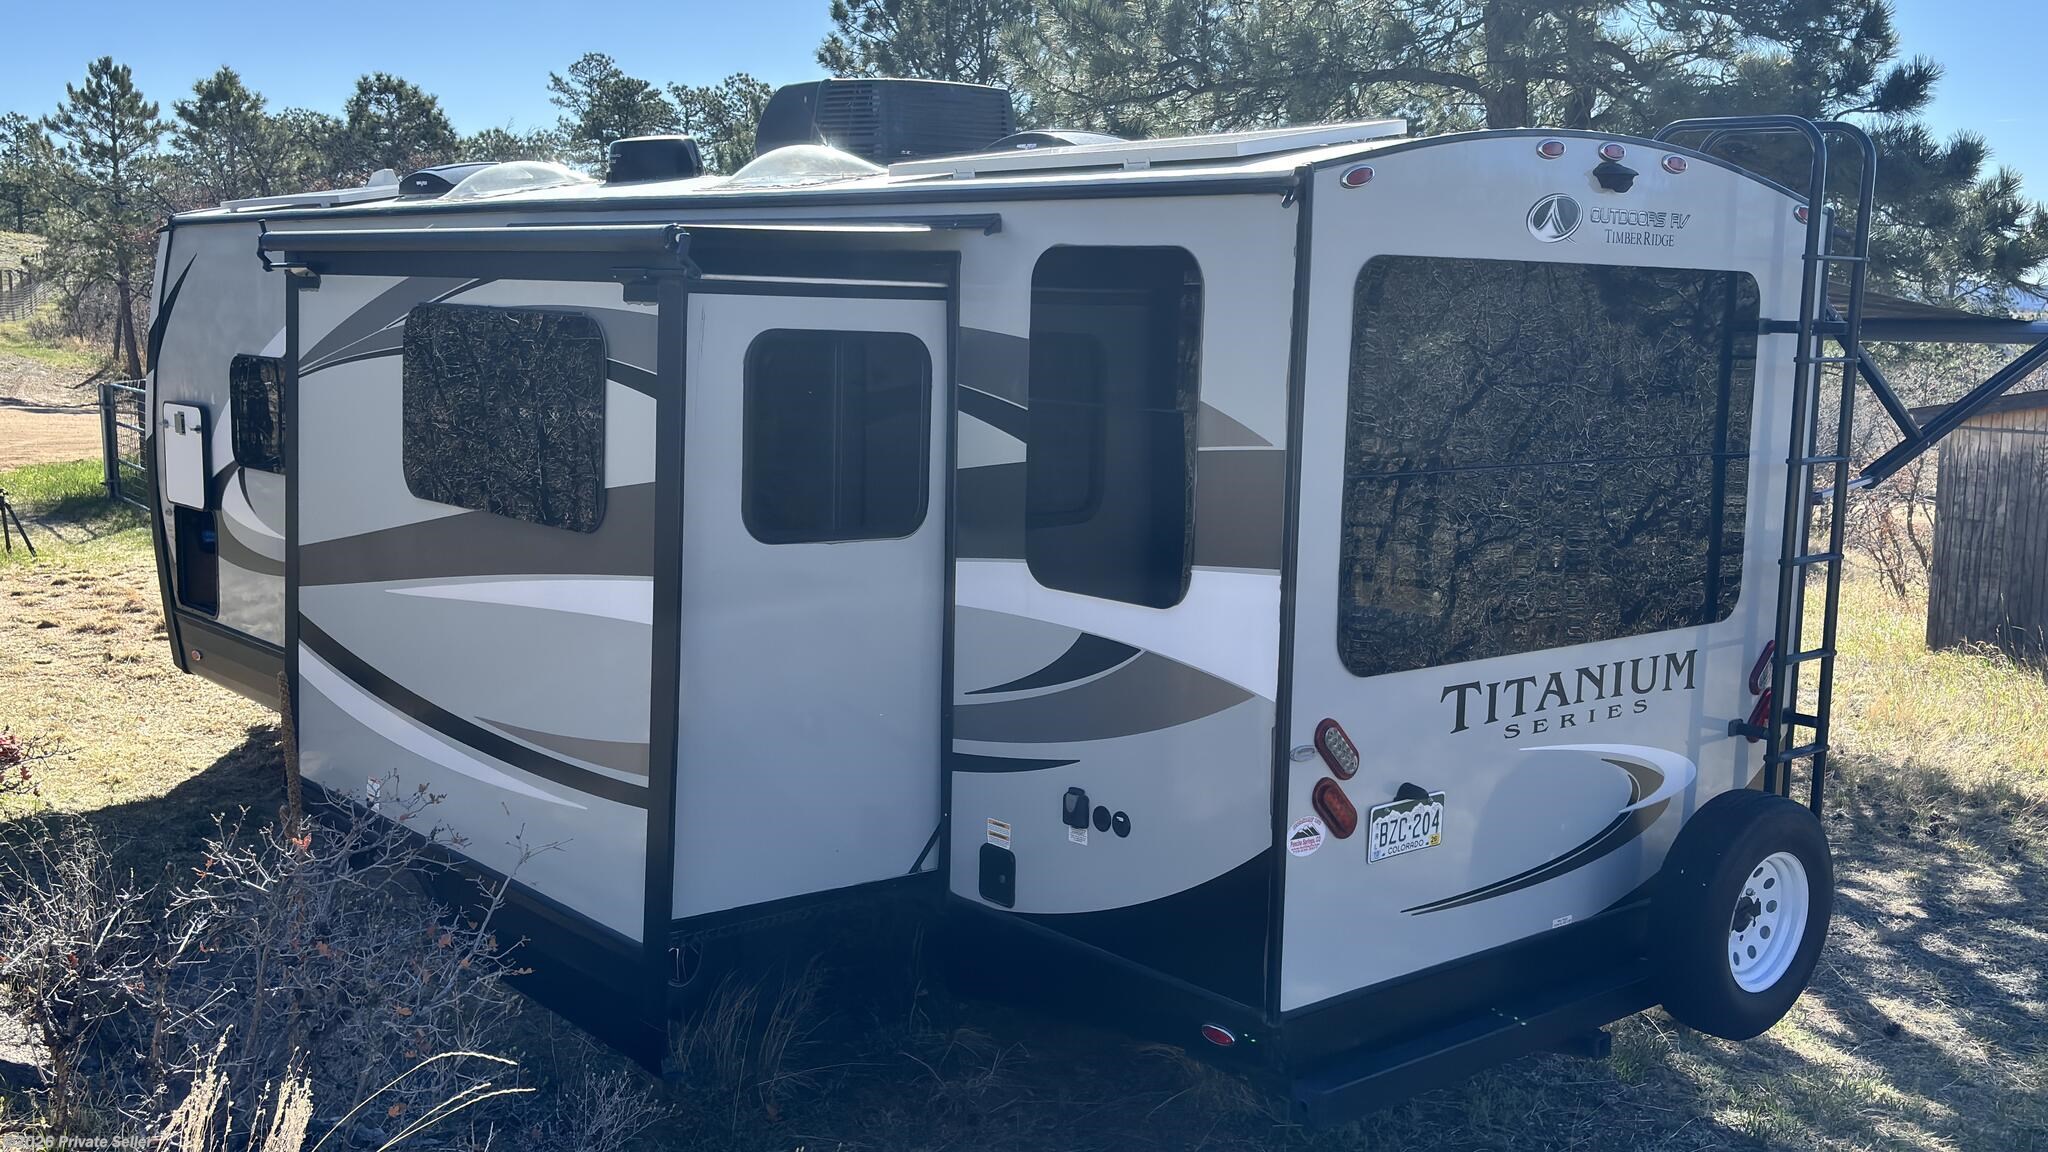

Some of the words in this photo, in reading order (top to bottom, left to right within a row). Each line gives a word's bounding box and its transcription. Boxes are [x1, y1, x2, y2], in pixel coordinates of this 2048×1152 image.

[1590, 206, 1667, 228] OUTDOORS
[1670, 212, 1692, 230] RV
[1440, 649, 1698, 734] TITANIUM
[1504, 699, 1648, 739] SERIES
[1387, 839, 1425, 855] COLORADO
